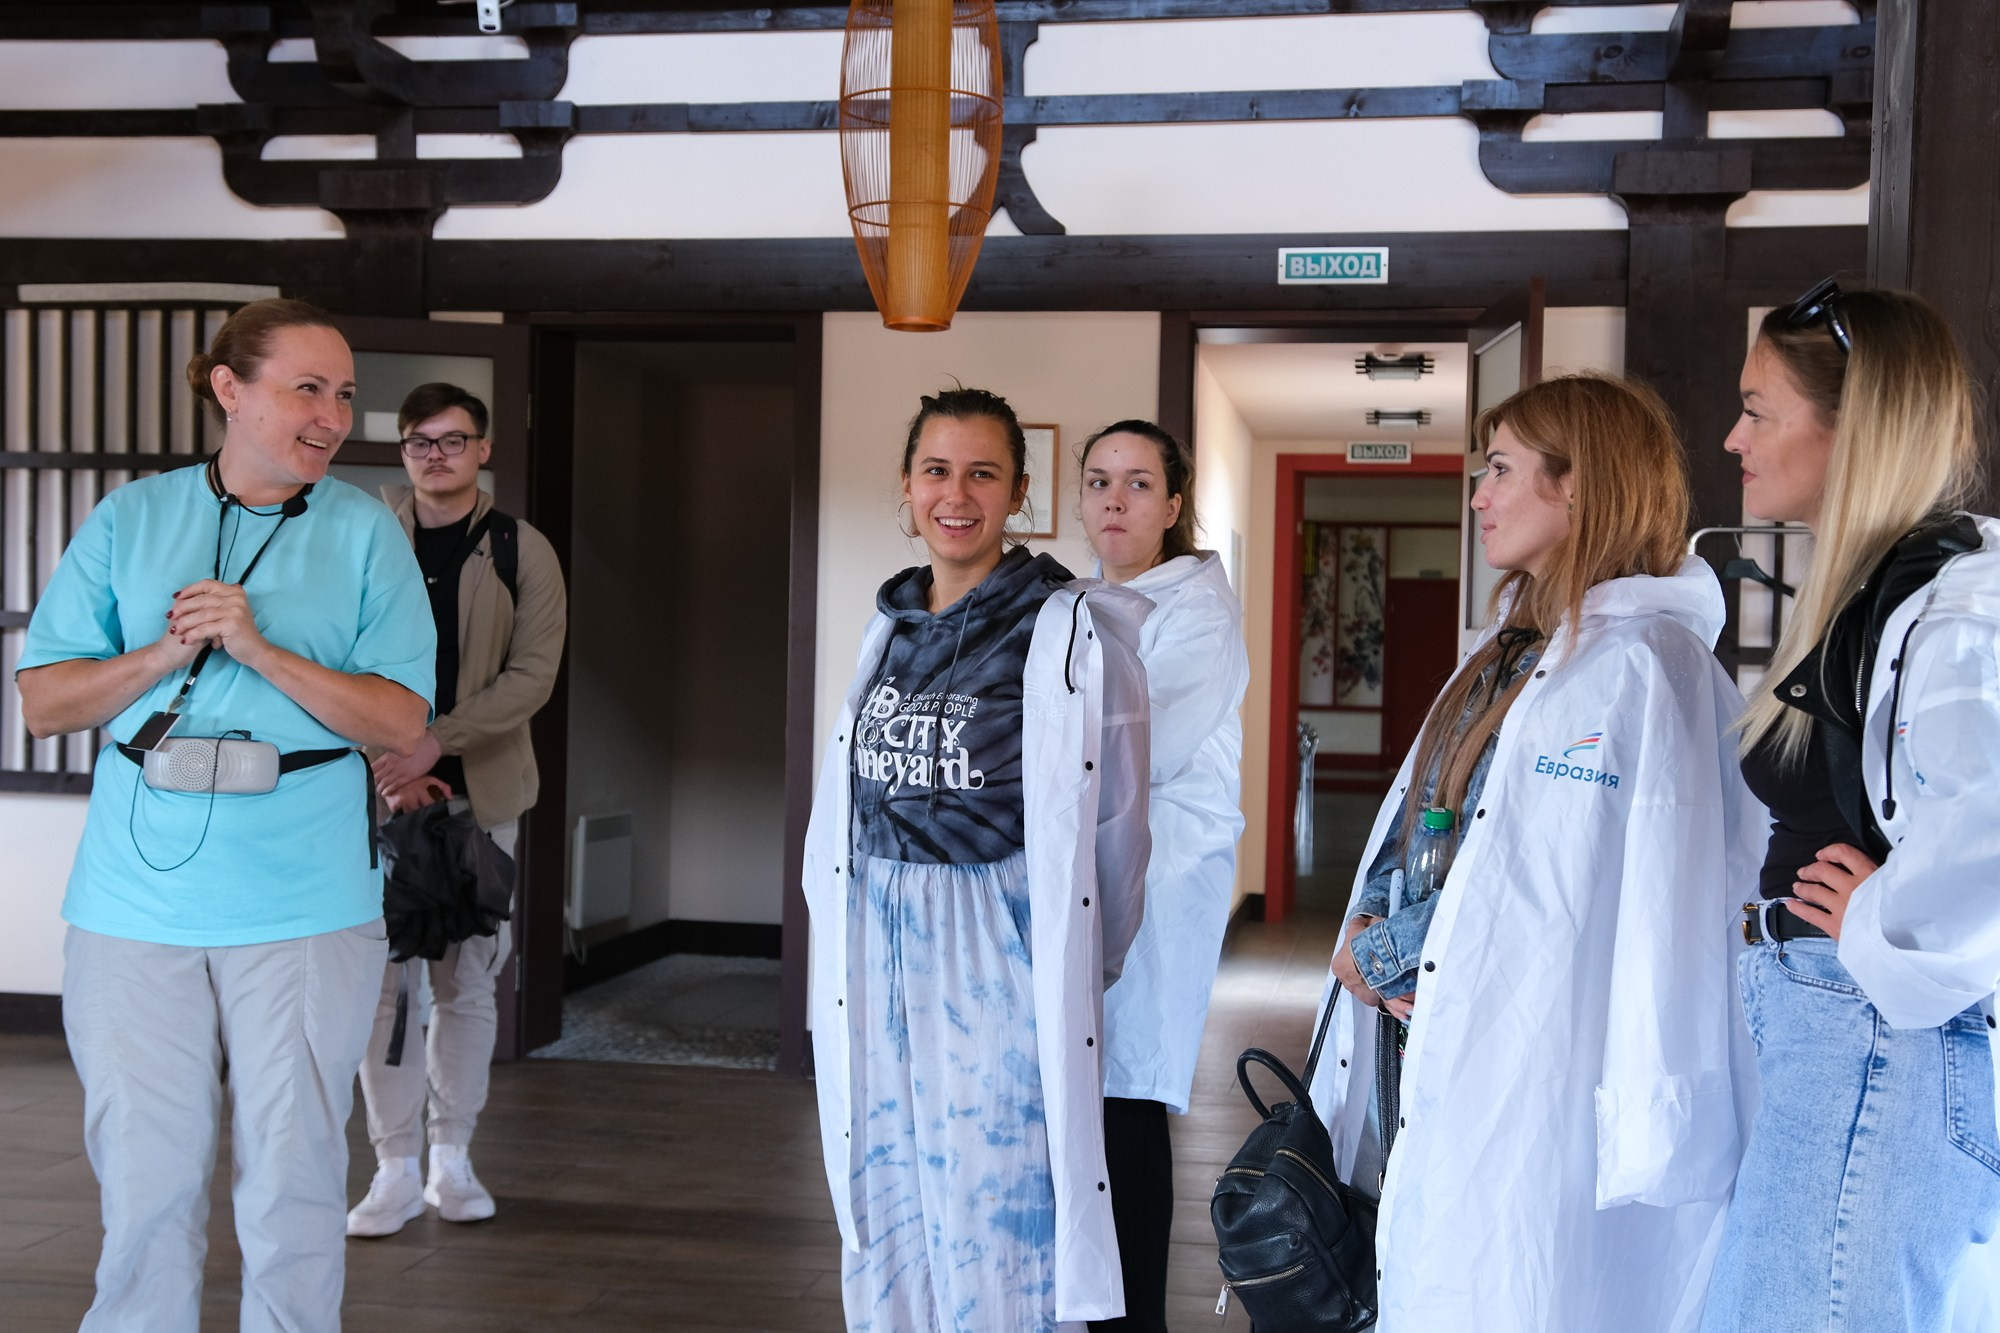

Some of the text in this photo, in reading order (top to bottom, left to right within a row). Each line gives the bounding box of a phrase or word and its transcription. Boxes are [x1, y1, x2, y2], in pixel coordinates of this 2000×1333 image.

[1290, 255, 1378, 277] ВЫХОД
[1353, 446, 1405, 458] ВЫХОД
[903, 691, 979, 707] A Church Ebracing
[899, 701, 977, 718] GOD & POPLE
[883, 713, 967, 754] CITY
[1535, 755, 1620, 789] Евразия
